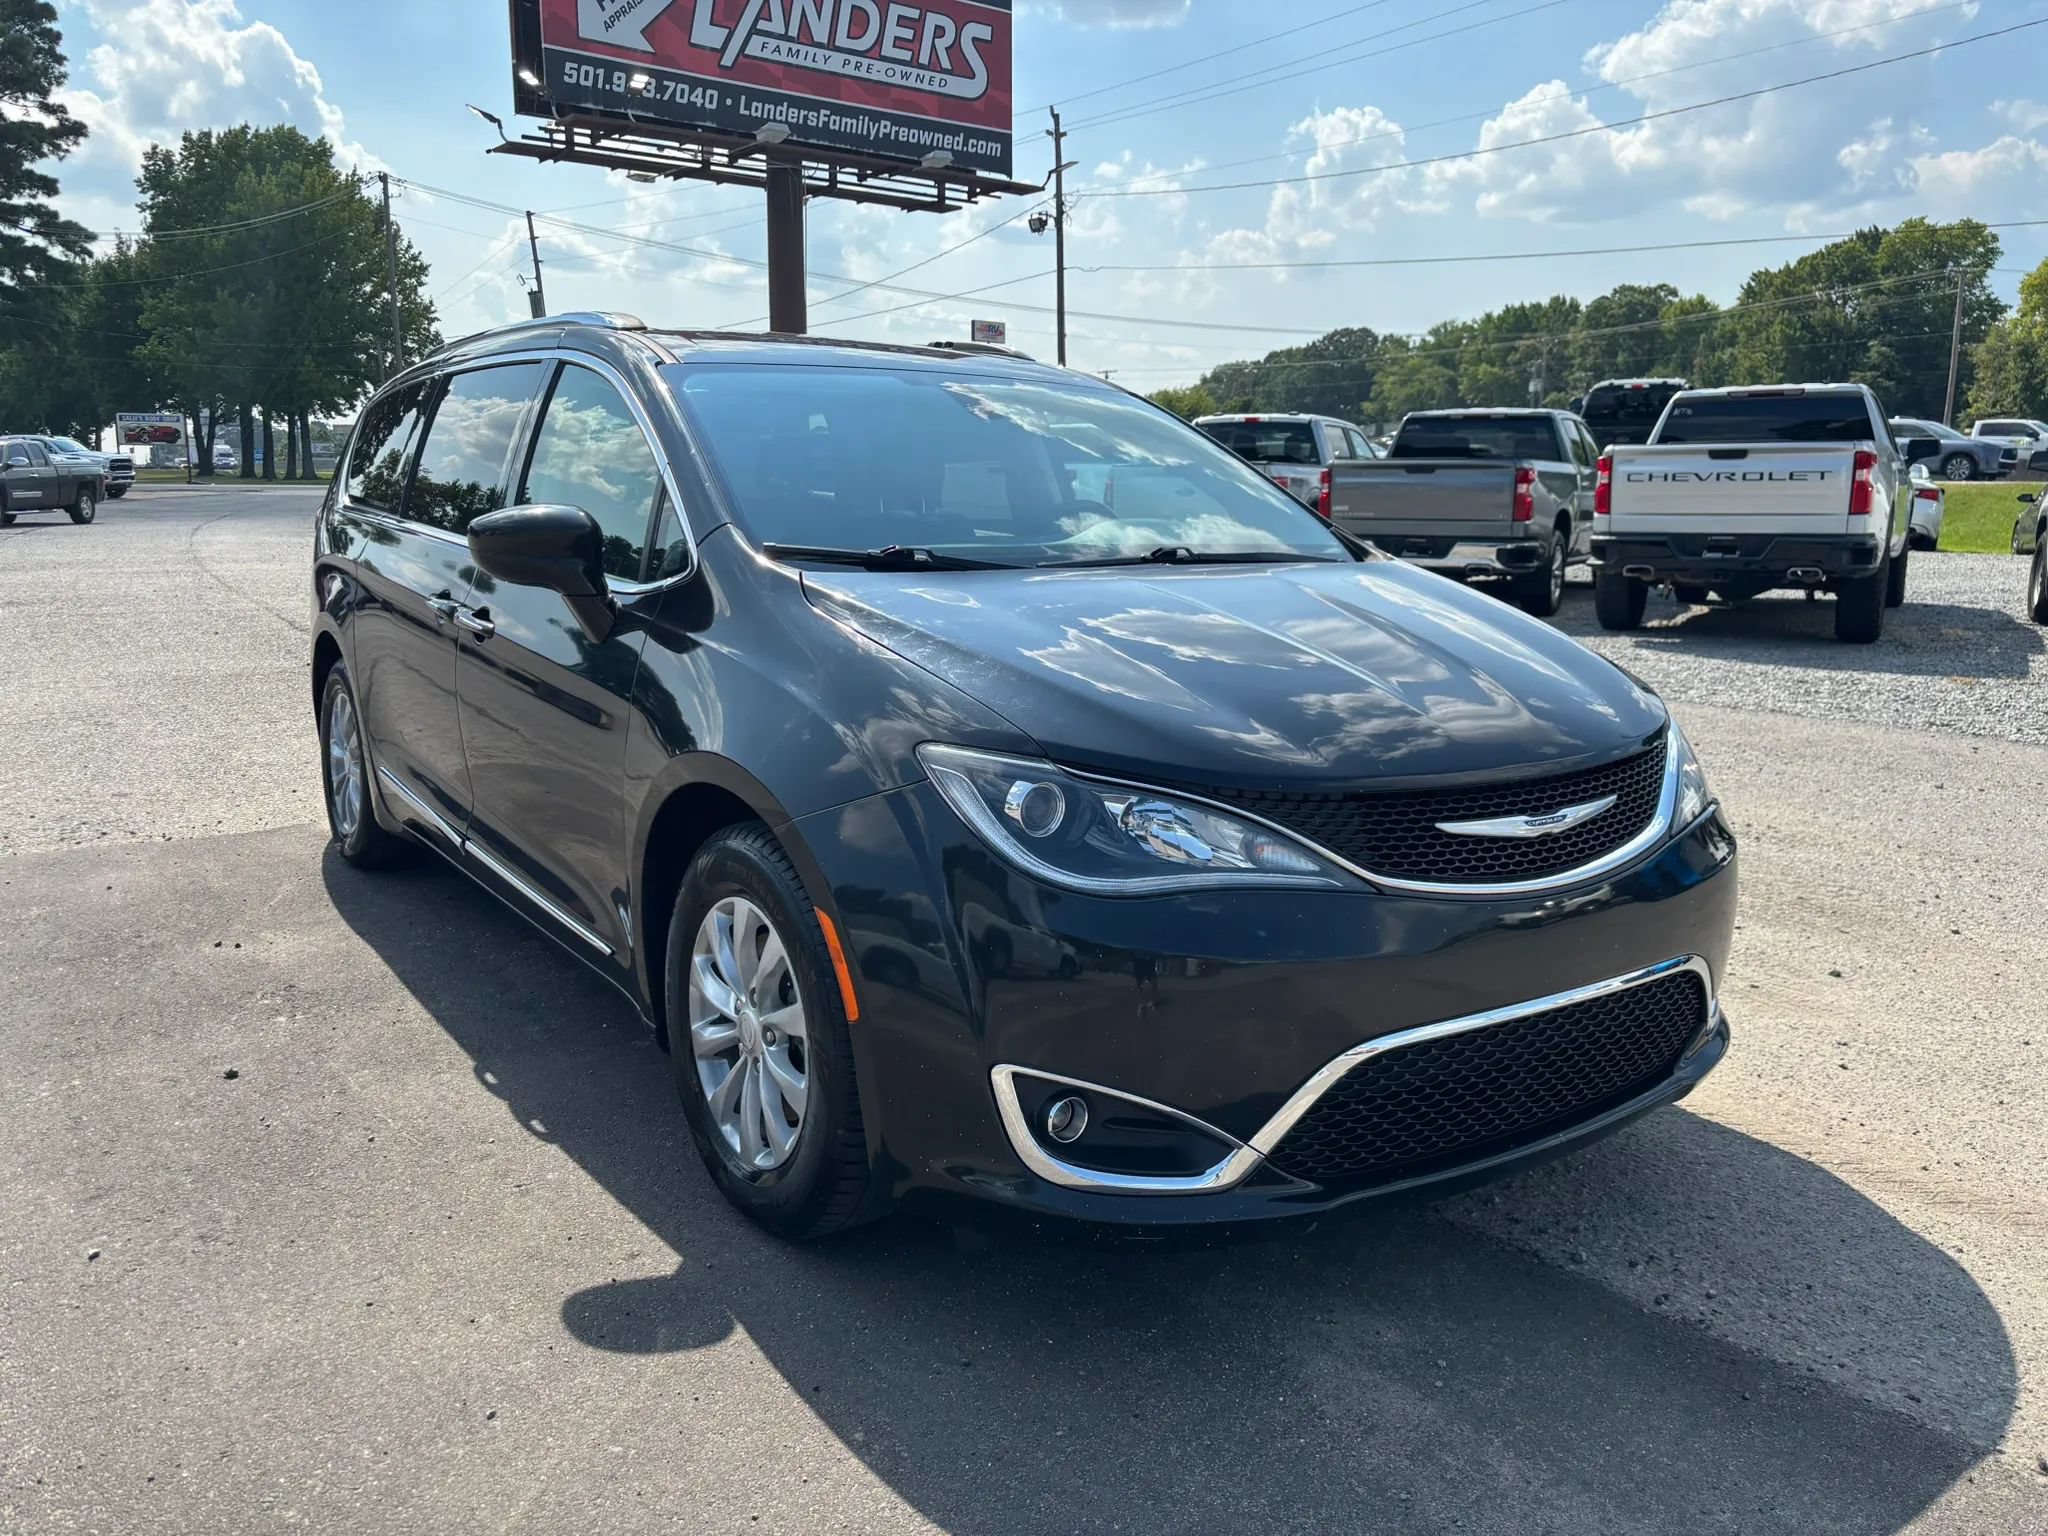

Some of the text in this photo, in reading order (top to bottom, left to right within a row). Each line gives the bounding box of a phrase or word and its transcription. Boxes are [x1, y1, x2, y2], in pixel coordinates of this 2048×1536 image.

[689, 0, 993, 98] LANDERS
[760, 41, 948, 89] FAMILY PRE-OWNED
[563, 61, 1001, 157] 501.93.7040 LandersFamilyPreowned.com
[1626, 470, 1833, 483] CHEVROLET
